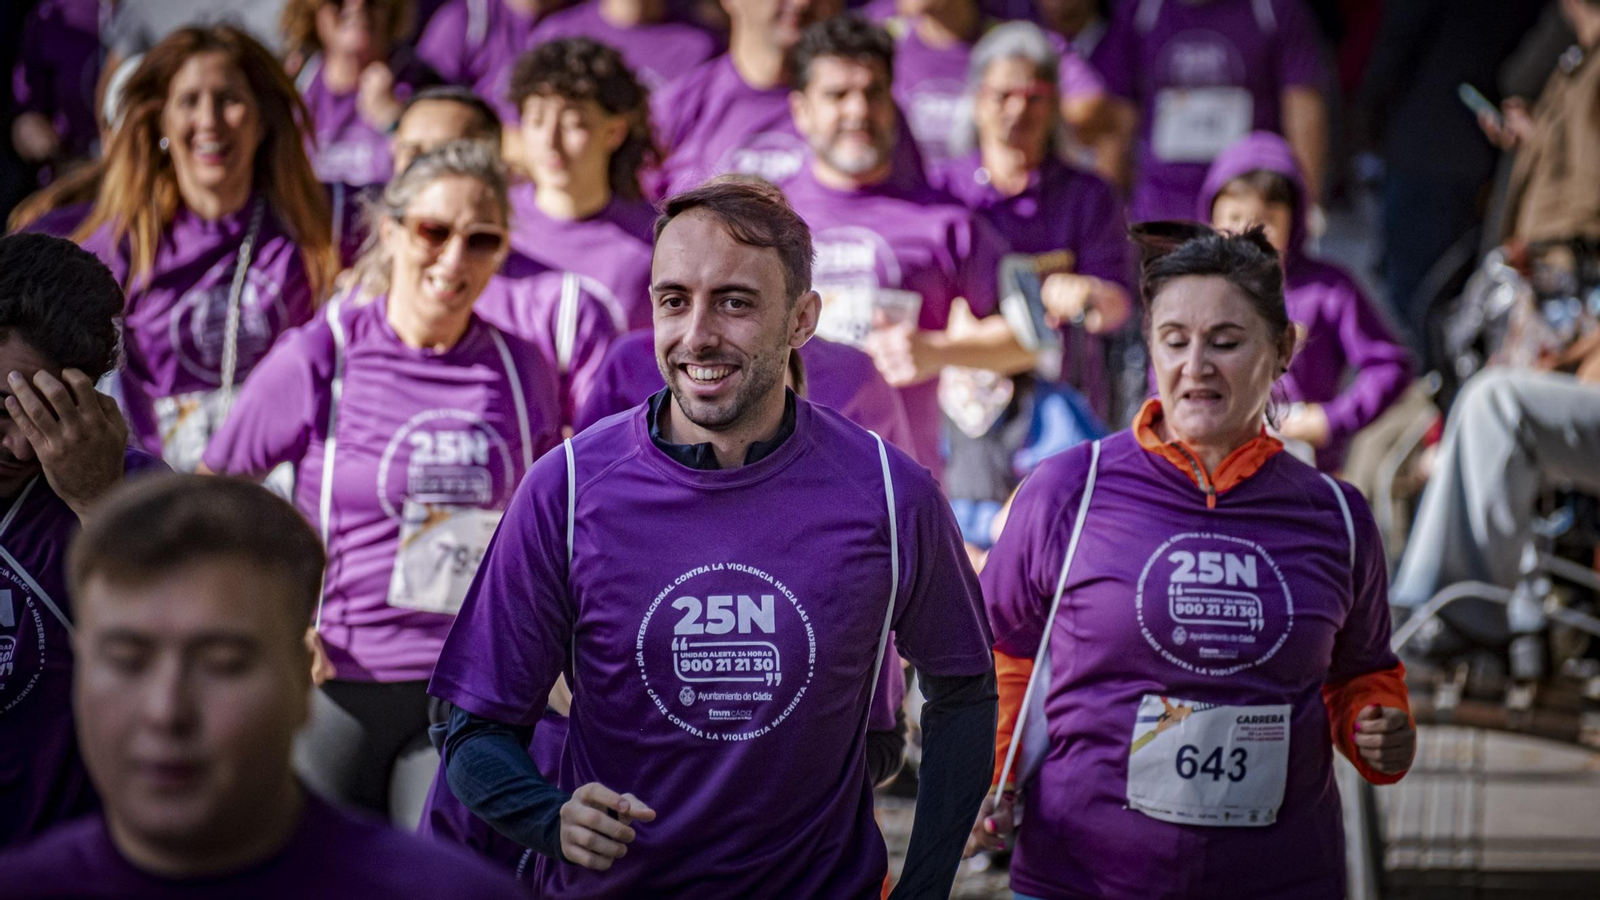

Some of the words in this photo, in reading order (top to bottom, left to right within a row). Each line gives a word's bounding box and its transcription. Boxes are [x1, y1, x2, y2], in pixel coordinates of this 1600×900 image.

[407, 430, 490, 466] 25N
[674, 565, 710, 586] CONTRA
[712, 563, 724, 571] LA
[726, 562, 774, 584] VIOLENCIA
[1167, 550, 1258, 588] 25N
[774, 580, 798, 605] HACIA
[636, 584, 675, 650] INTERNACIONAL
[671, 594, 776, 635] 25N
[795, 604, 809, 622] LAS
[1175, 603, 1204, 615] 900
[1206, 604, 1220, 616] 21
[1223, 605, 1237, 617] 21
[1239, 606, 1257, 618] 30
[31, 608, 45, 650] MUJERES
[804, 622, 816, 665] MUJERES
[635, 650, 645, 667] DÍA
[680, 658, 713, 672] 900
[715, 658, 732, 672] 21
[734, 658, 751, 672] 21
[753, 658, 774, 672] 30
[1161, 650, 1193, 671] CONTRA
[1195, 667, 1207, 675] LA
[5, 673, 40, 710] MACHISTA
[697, 691, 742, 702] Ayuntamiento
[743, 692, 751, 701] de
[752, 691, 773, 701] Cádiz
[647, 689, 668, 715] CÁDIZ
[668, 714, 703, 738] CONTRA
[706, 732, 719, 740] LA
[722, 725, 771, 741] VIOLENCIA
[772, 686, 807, 728] MACHISTA
[1236, 714, 1285, 724] CARRERA
[1175, 744, 1248, 782] 643
